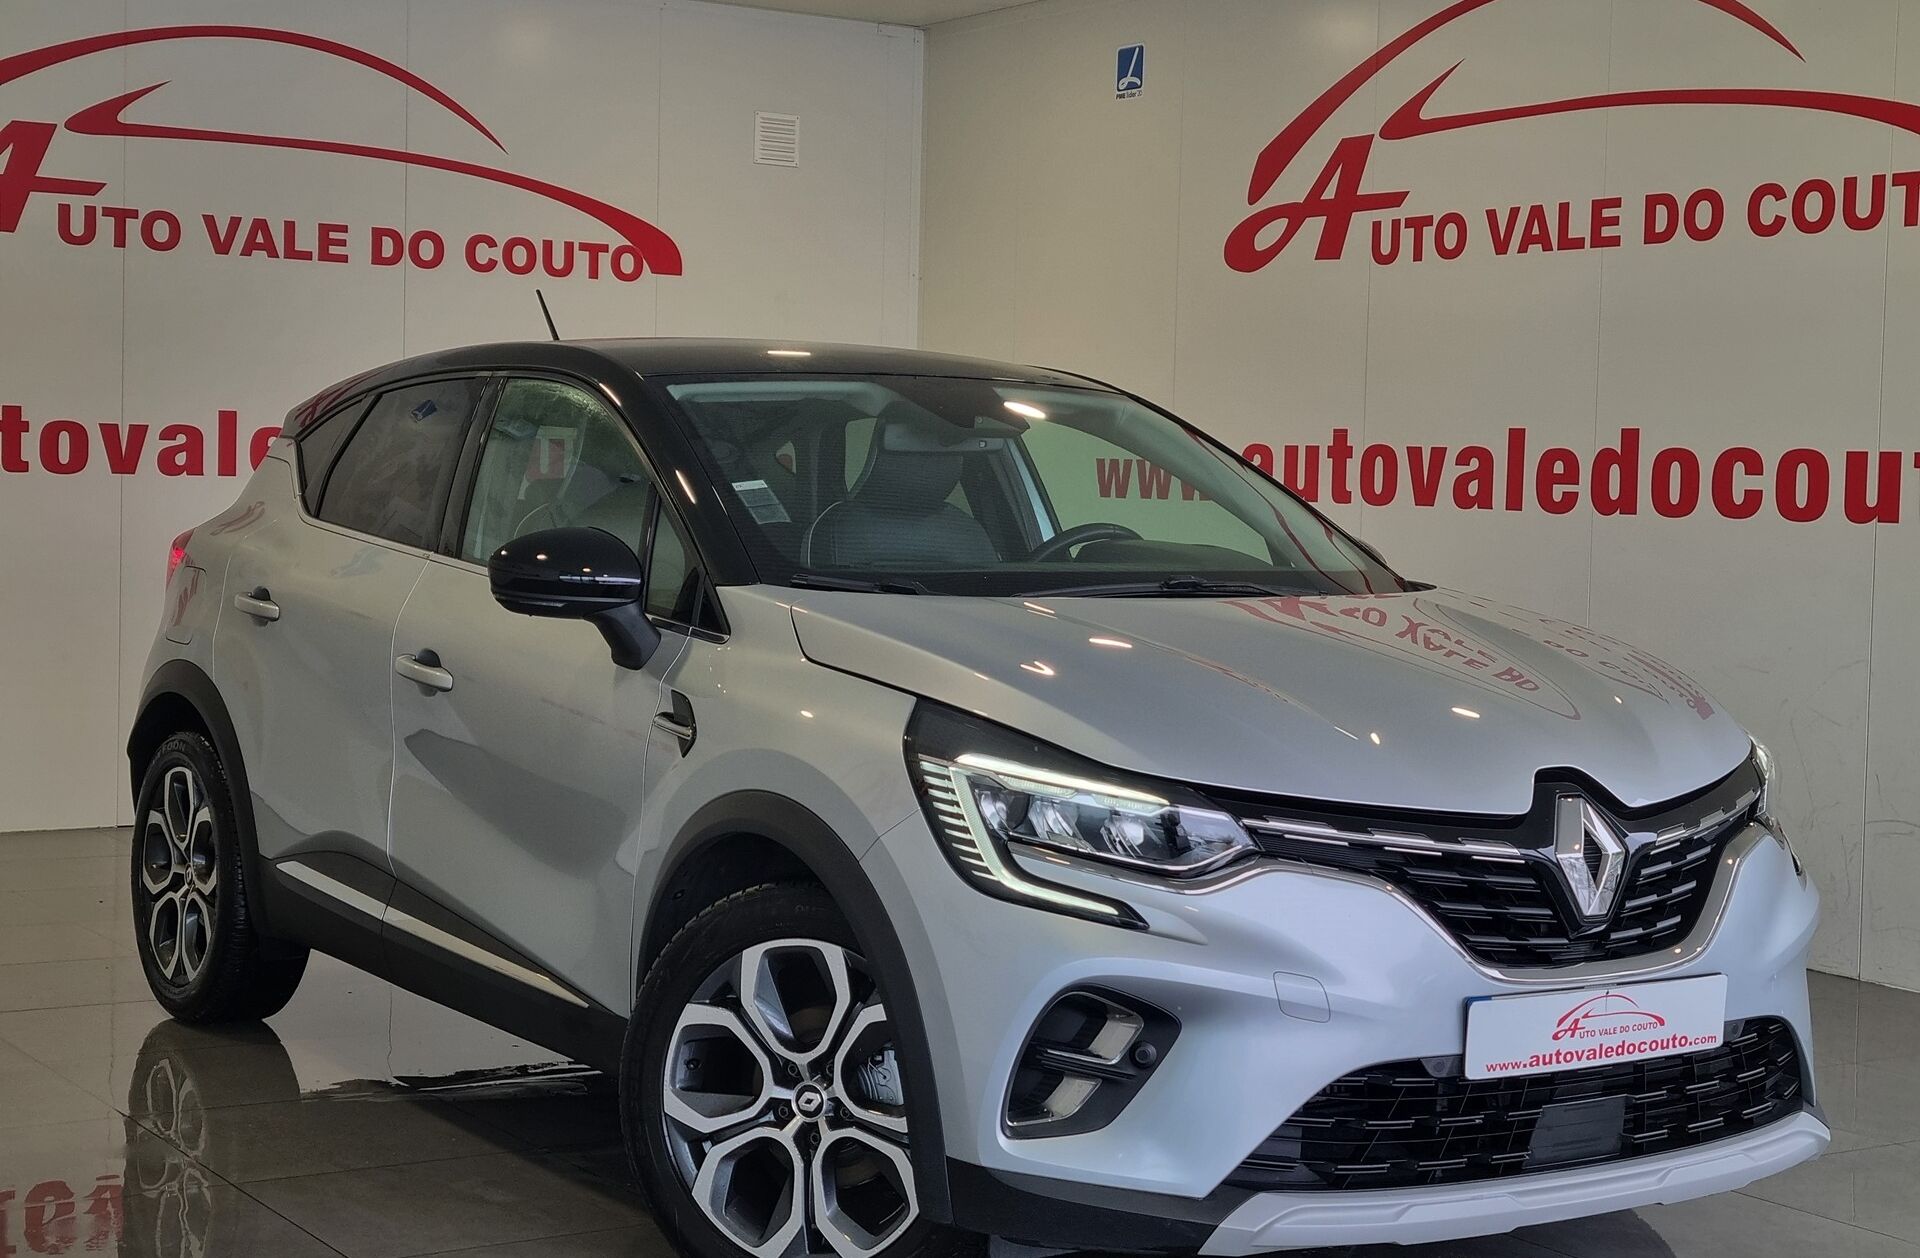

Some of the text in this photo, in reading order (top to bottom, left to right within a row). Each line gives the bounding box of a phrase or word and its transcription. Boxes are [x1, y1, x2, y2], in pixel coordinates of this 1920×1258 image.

[1224, 134, 1920, 273] AUTO VALE DO COUT
[202, 214, 349, 264] VALE
[370, 226, 446, 270] DO
[464, 233, 645, 283] COUTO
[1486, 1033, 1717, 1072] www.autovaledocouto.com
[1552, 1017, 1658, 1041] AUTO VALE DO COUTO
